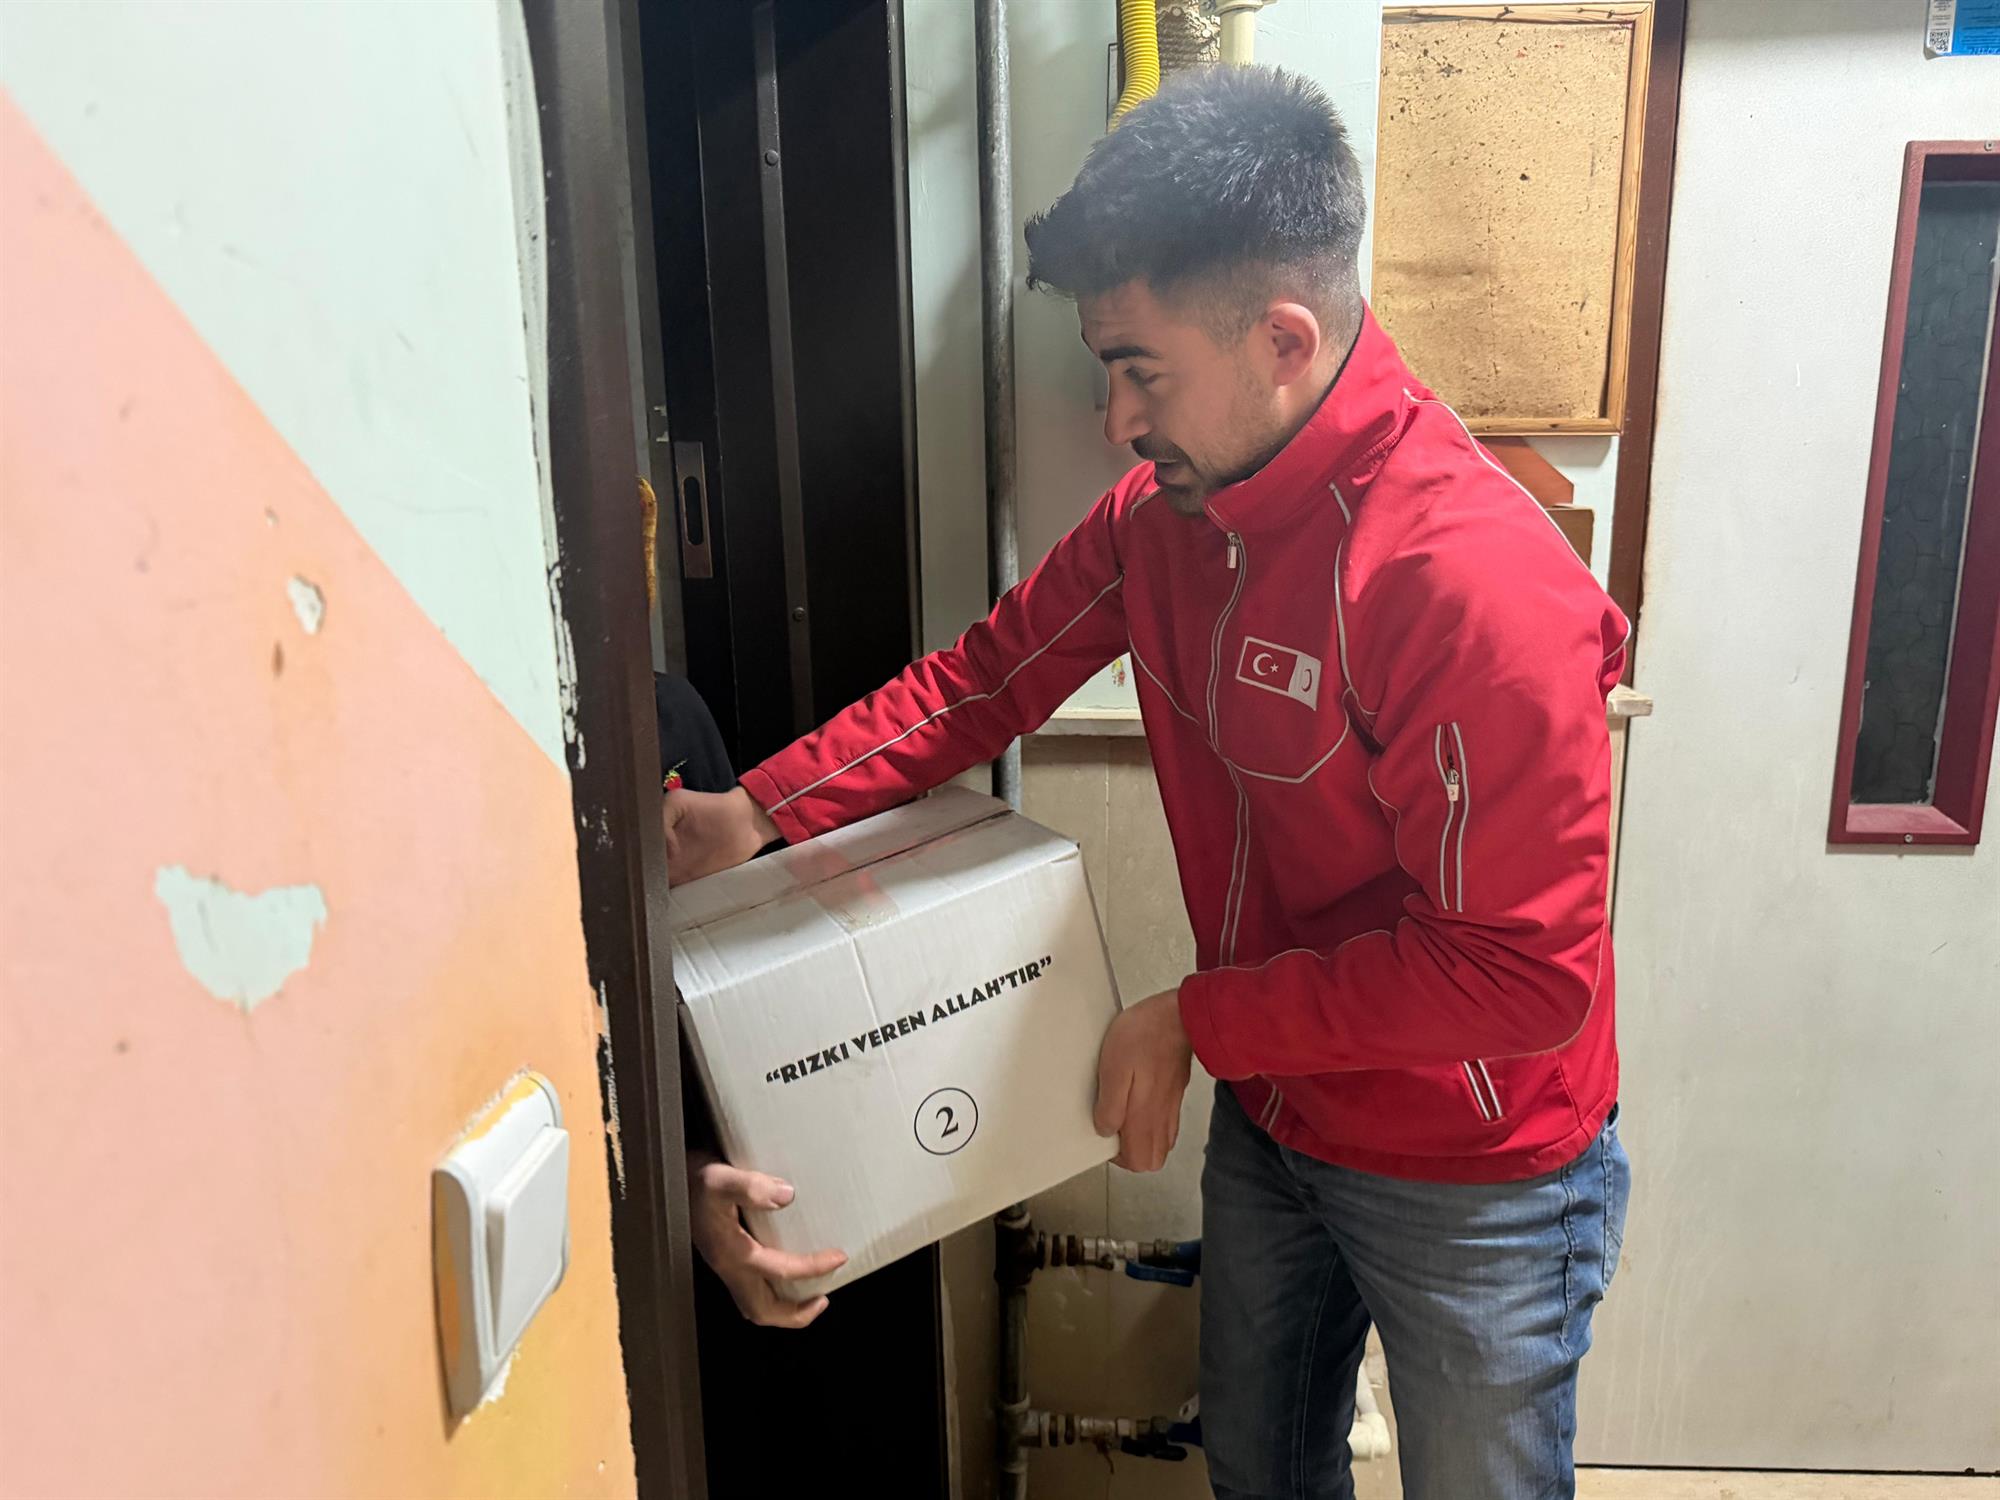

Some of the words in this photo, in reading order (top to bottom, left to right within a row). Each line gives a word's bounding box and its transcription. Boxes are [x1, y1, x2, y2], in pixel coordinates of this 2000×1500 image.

[765, 1041, 850, 1084] “RIZKI
[850, 1010, 926, 1053] VEREN
[935, 1105, 959, 1138] 2
